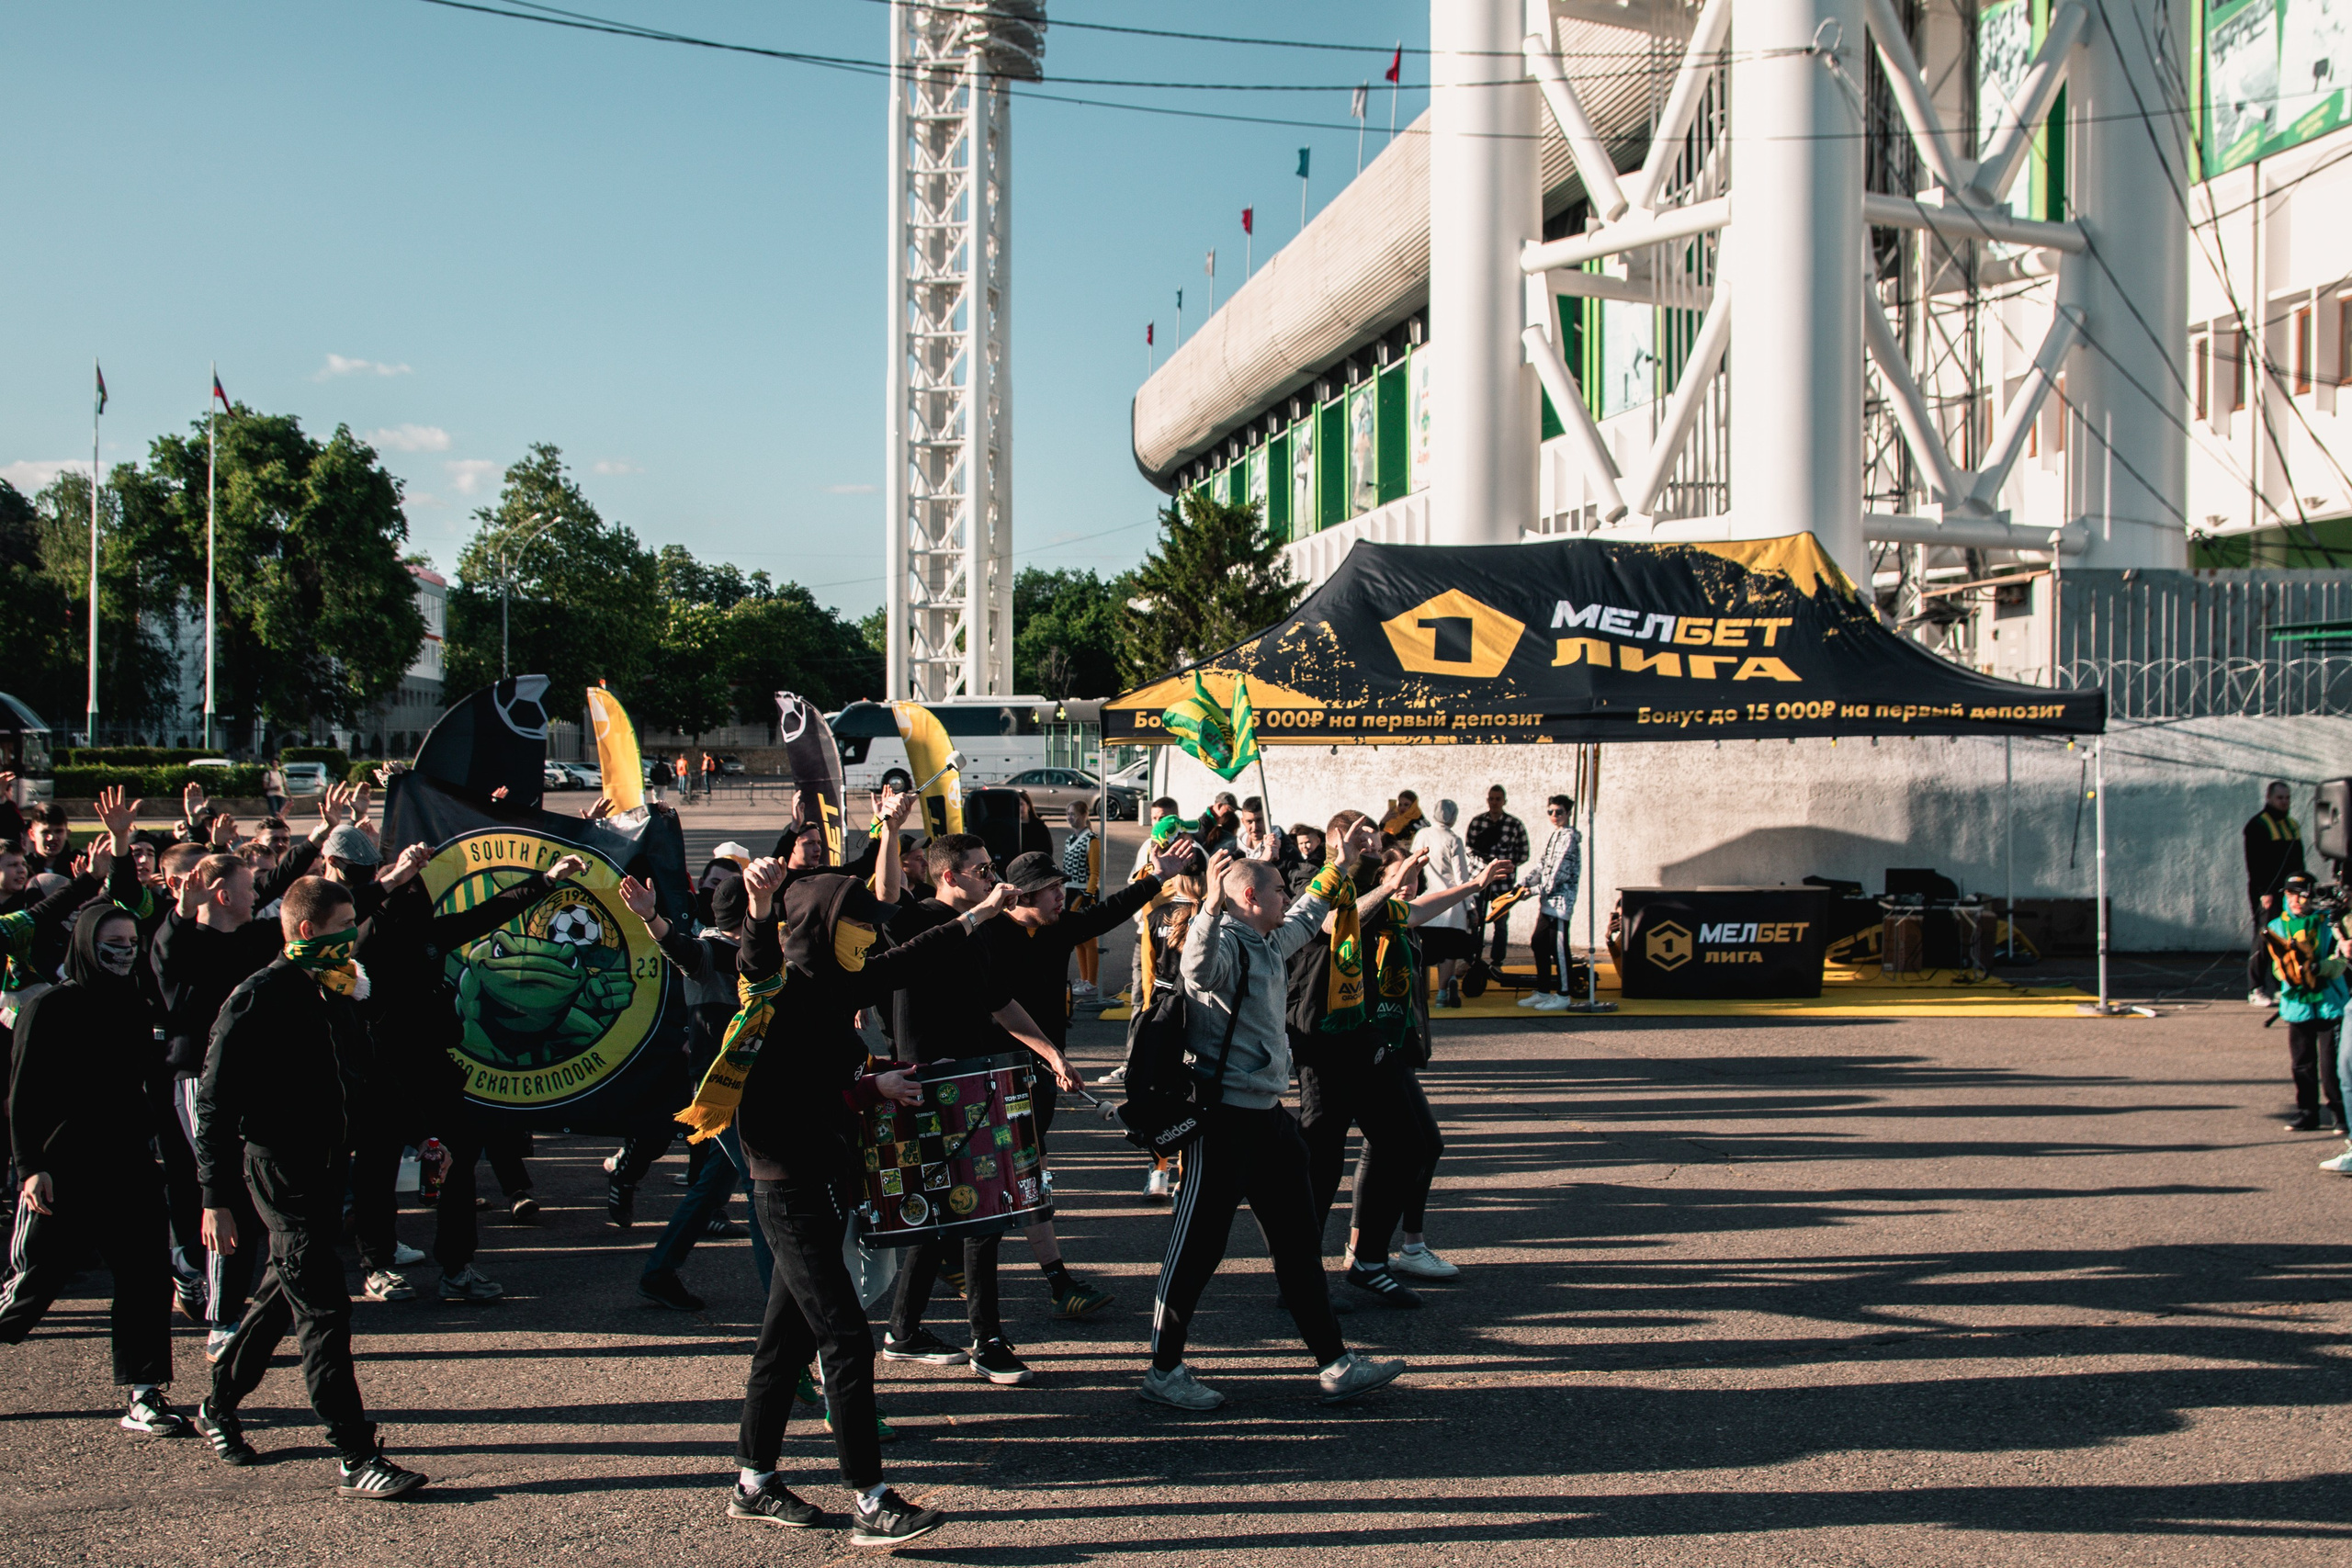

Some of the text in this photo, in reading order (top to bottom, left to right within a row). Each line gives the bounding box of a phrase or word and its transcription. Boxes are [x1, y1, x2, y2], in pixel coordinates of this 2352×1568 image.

[1551, 600, 1793, 647] МЕЛБЕТ
[1551, 637, 1804, 682] ЛИГА
[1329, 716, 1356, 728] на
[1362, 710, 1447, 732] первый
[1452, 714, 1544, 729] депозит
[1637, 706, 1704, 728] Бонус
[1708, 708, 1738, 725] до
[1747, 703, 1770, 721] 15
[1840, 704, 1870, 718] на
[1874, 703, 1964, 723] первый
[1969, 704, 2065, 720] депозит
[470, 840, 529, 863] SOUTH
[1699, 921, 1810, 943] МЕЛБЕТ
[637, 956, 658, 979] 23
[1704, 951, 1763, 963] ЛИГА
[1376, 1001, 1404, 1015] AVA
[1155, 1117, 1197, 1145] adidas
